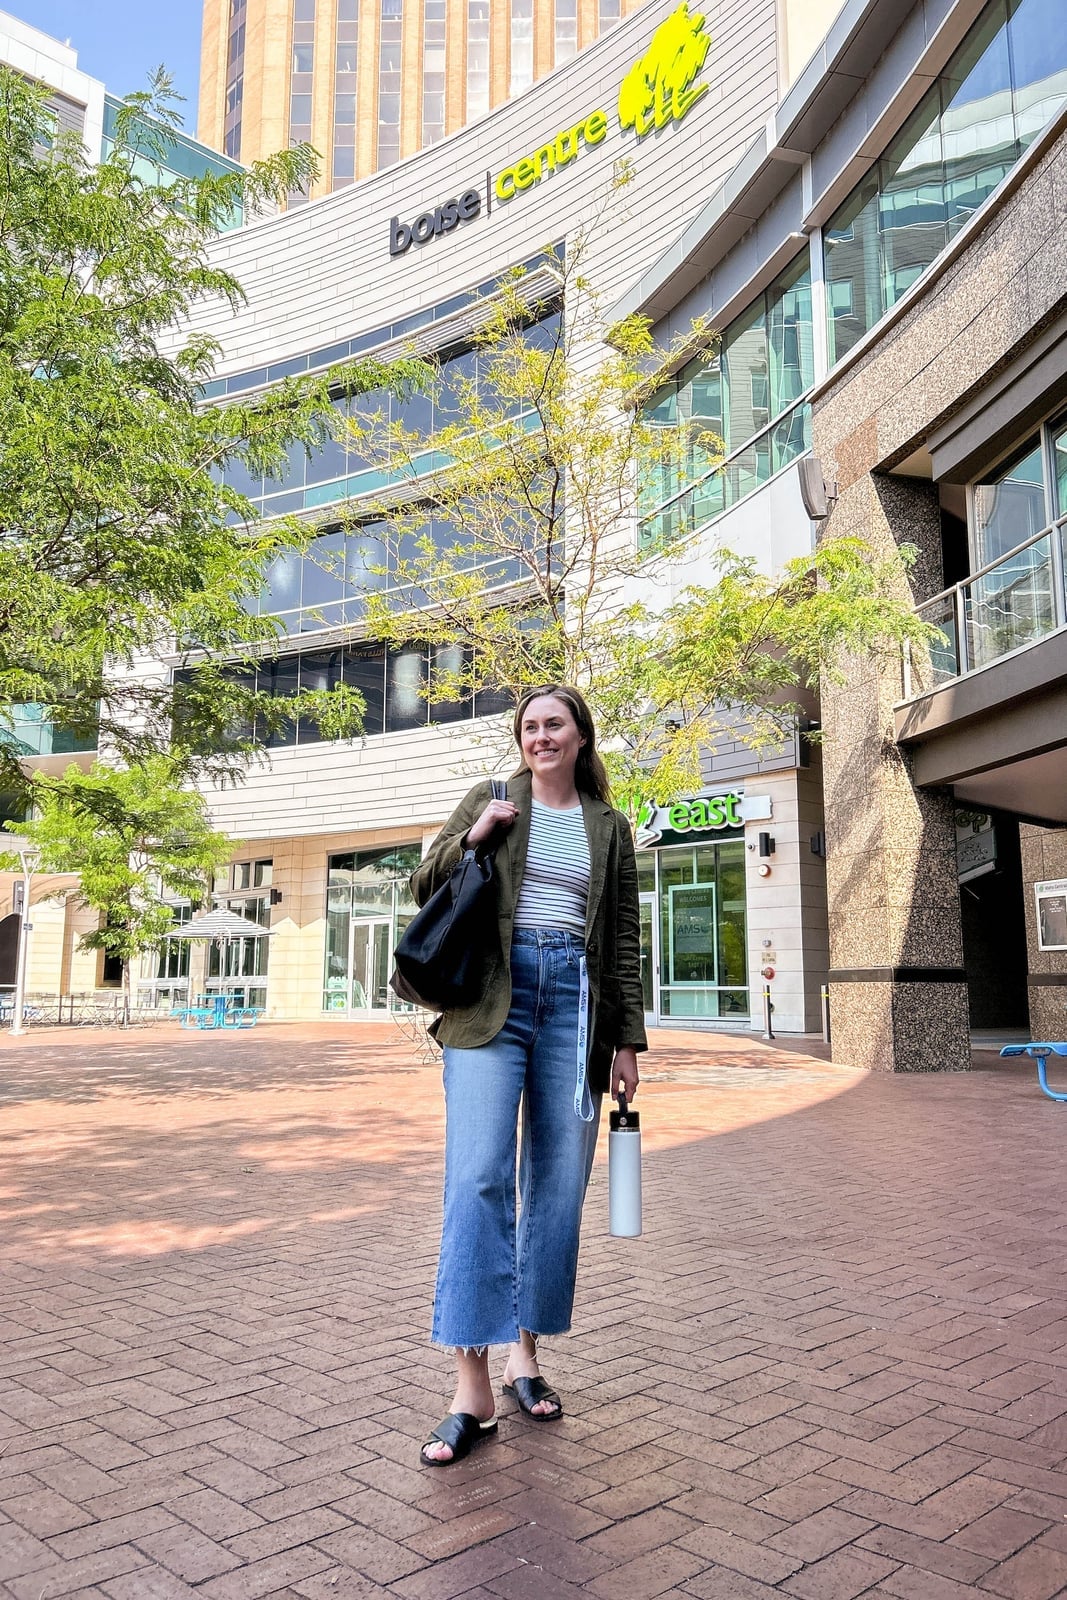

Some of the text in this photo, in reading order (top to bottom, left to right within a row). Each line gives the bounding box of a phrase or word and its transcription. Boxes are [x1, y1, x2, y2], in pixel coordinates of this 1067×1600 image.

[389, 109, 608, 255] boise centre
[669, 793, 739, 829] east
